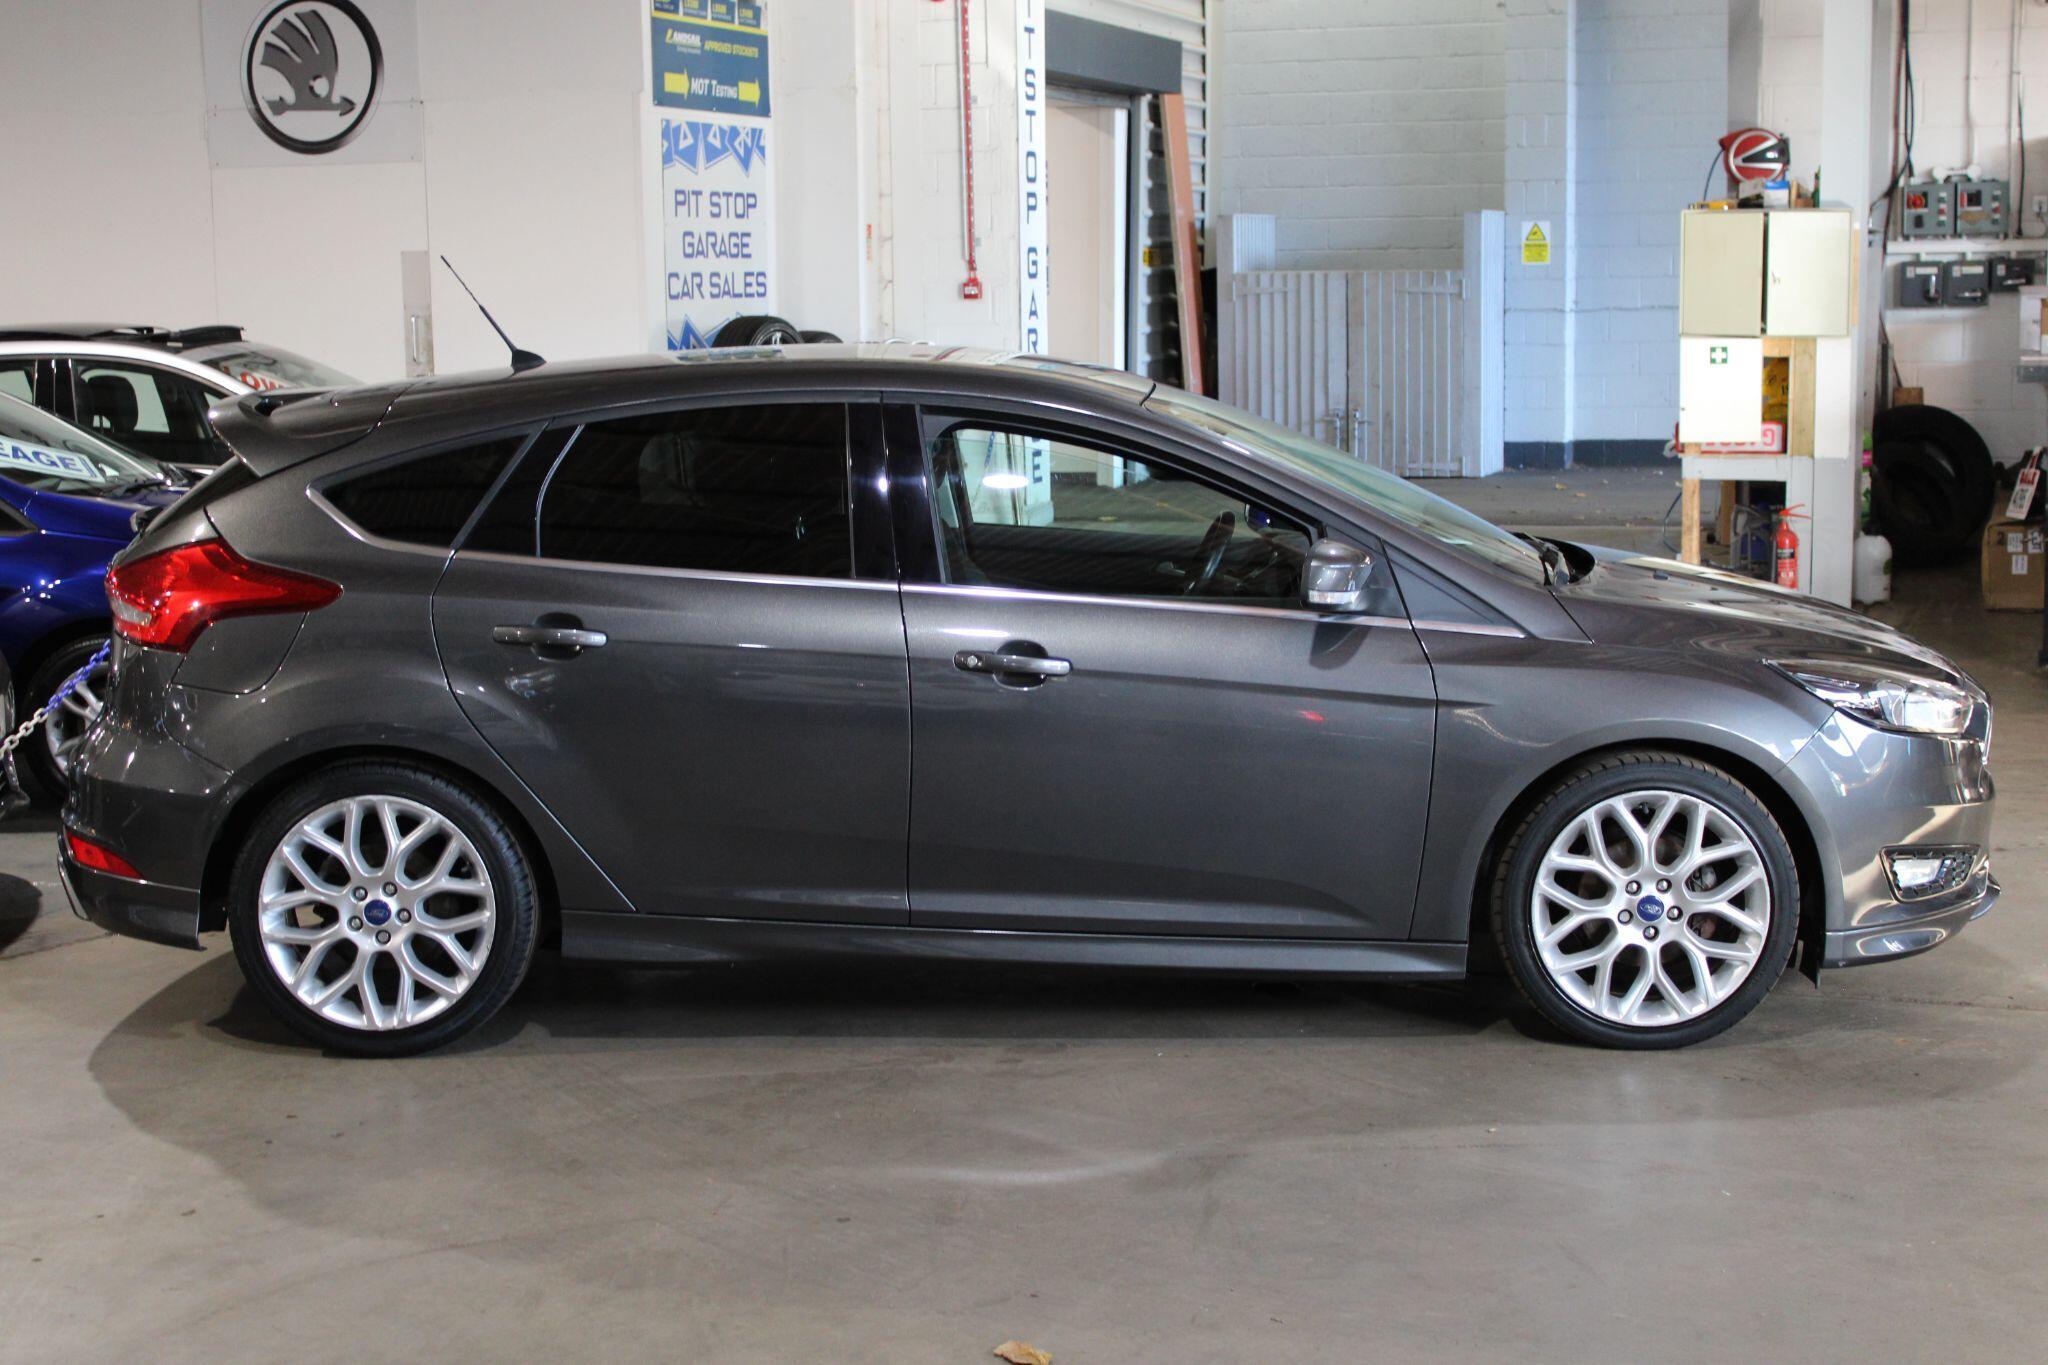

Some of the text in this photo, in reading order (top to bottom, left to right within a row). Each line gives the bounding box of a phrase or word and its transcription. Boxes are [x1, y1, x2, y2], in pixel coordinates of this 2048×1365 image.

[690, 77, 709, 96] MOT
[1025, 68, 1038, 225] STOP
[674, 189, 758, 219] PIT STOP
[682, 231, 752, 258] GARAGE
[667, 271, 767, 300] CAR SALES
